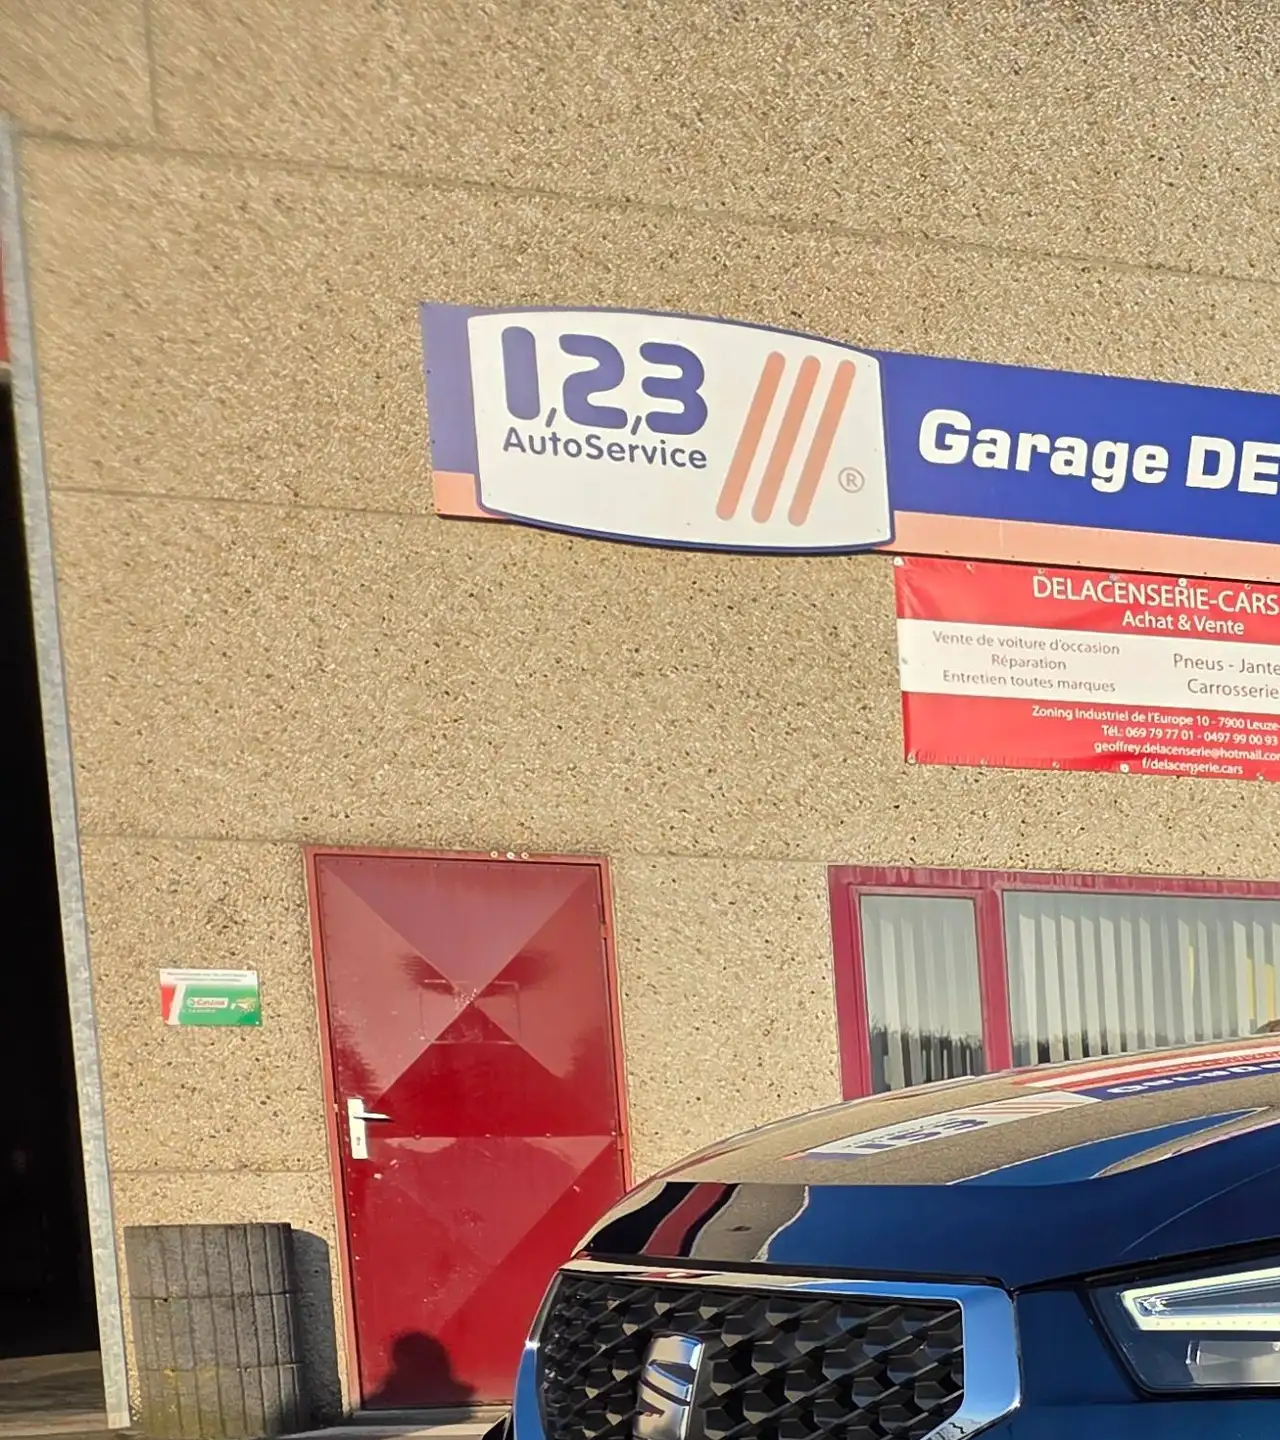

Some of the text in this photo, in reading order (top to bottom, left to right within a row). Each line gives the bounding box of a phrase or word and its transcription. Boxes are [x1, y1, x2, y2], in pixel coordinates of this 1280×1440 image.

[503, 426, 707, 468] AutoService
[919, 409, 1169, 493] Garage
[1032, 576, 1279, 615] DELACENSERIE-CARS
[1122, 610, 1244, 636] Achat & Vente
[933, 631, 1120, 656] Vente de voiture d'occasion
[991, 653, 1067, 671] Réparation
[1173, 653, 1224, 671] Pneus
[943, 670, 1116, 694] Entretien toutes marques
[1187, 678, 1279, 699] Carrosserie
[1032, 706, 1073, 721] Zoning
[1075, 708, 1129, 722] Industriel
[1131, 711, 1146, 723] de
[1148, 712, 1193, 727] l'Europe
[1196, 715, 1210, 727] 10
[1218, 717, 1245, 730] 7900
[1125, 727, 1147, 738] 069
[1149, 728, 1163, 739] 79
[1166, 729, 1179, 740] 77
[1181, 730, 1194, 741] 01
[1204, 731, 1230, 743] 0497
[1232, 733, 1247, 745] 99
[1249, 735, 1262, 746] 00
[1264, 736, 1279, 747] 93
